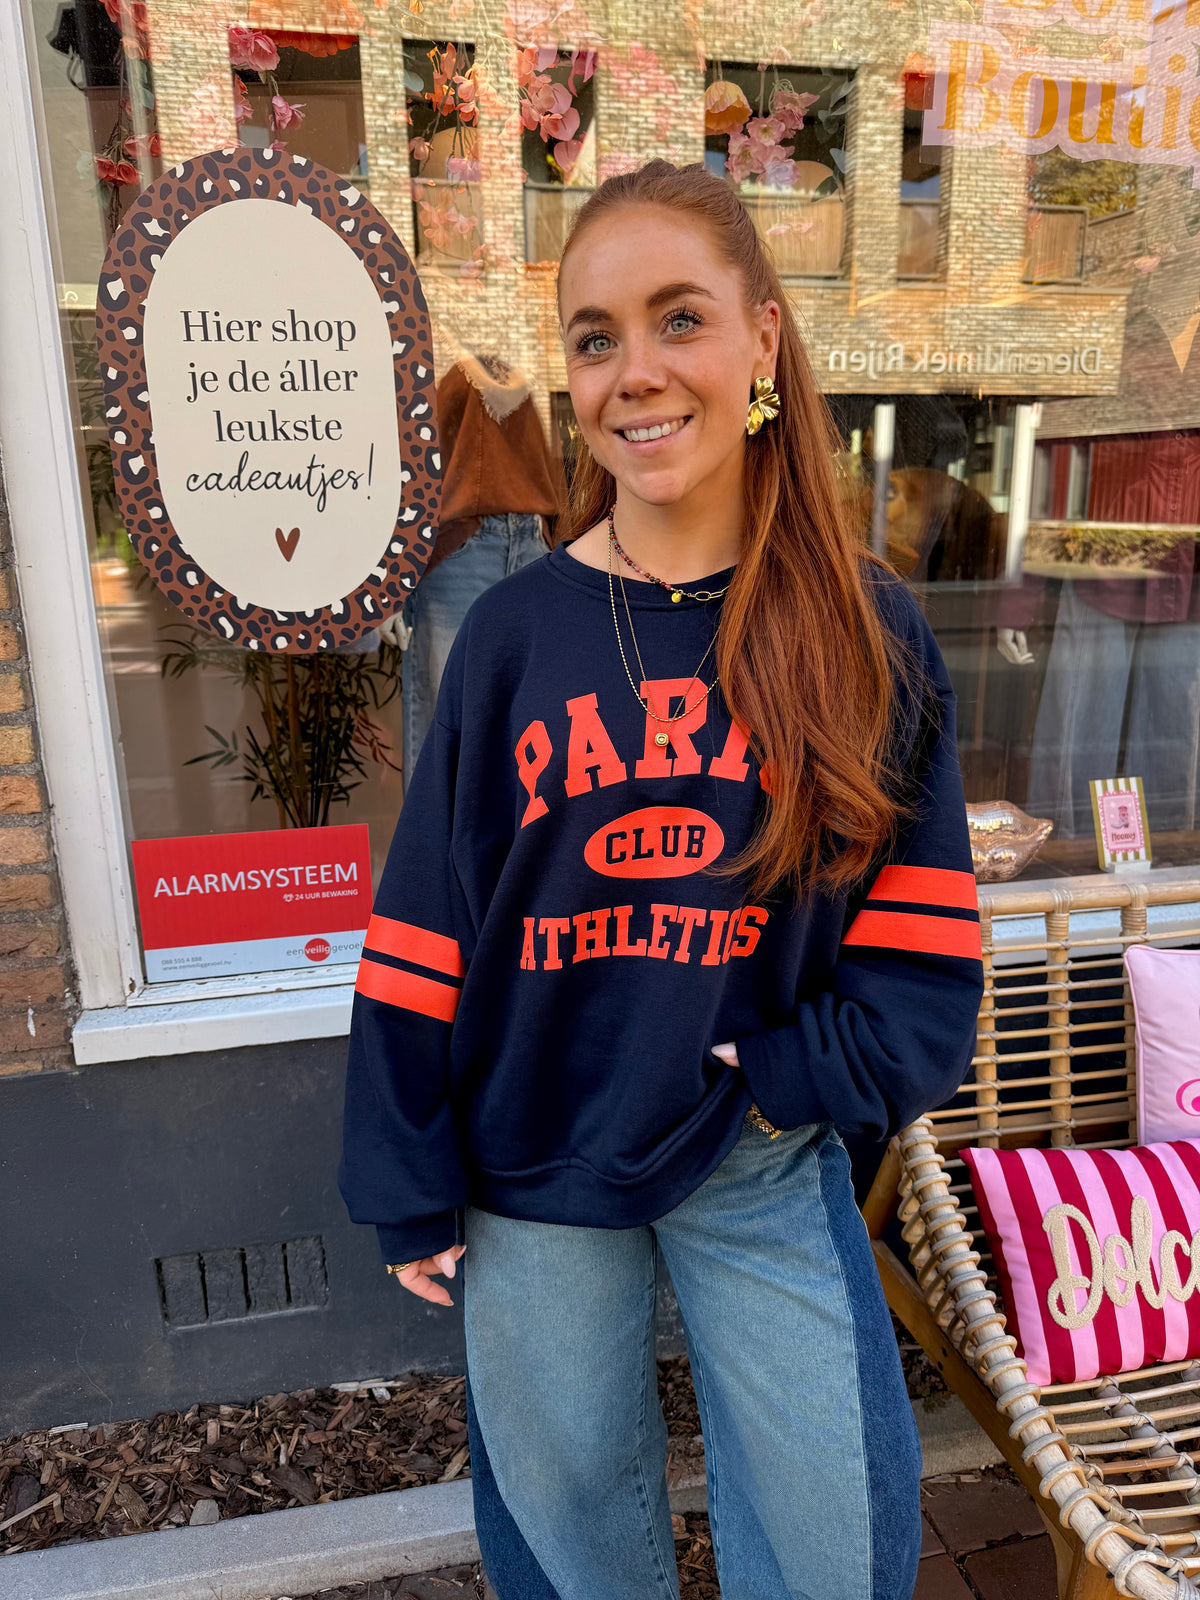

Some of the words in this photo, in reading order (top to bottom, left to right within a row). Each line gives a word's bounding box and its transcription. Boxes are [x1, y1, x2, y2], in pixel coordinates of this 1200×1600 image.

[937, 39, 1200, 152] Bouti
[180, 310, 262, 343] Hier
[271, 308, 357, 352] shop
[186, 362, 219, 403] je
[228, 360, 270, 393] de
[279, 359, 358, 392] áller
[213, 409, 343, 442] leukste
[186, 442, 374, 513] cadeautjes!
[514, 677, 781, 830] PARI
[605, 824, 707, 865] CLUB
[153, 862, 358, 898] ALARMSYSTEEM
[294, 893, 304, 901] 24
[305, 891, 321, 899] UUR
[321, 888, 359, 898] BEWAKING
[1042, 1196, 1200, 1329] Dolc
